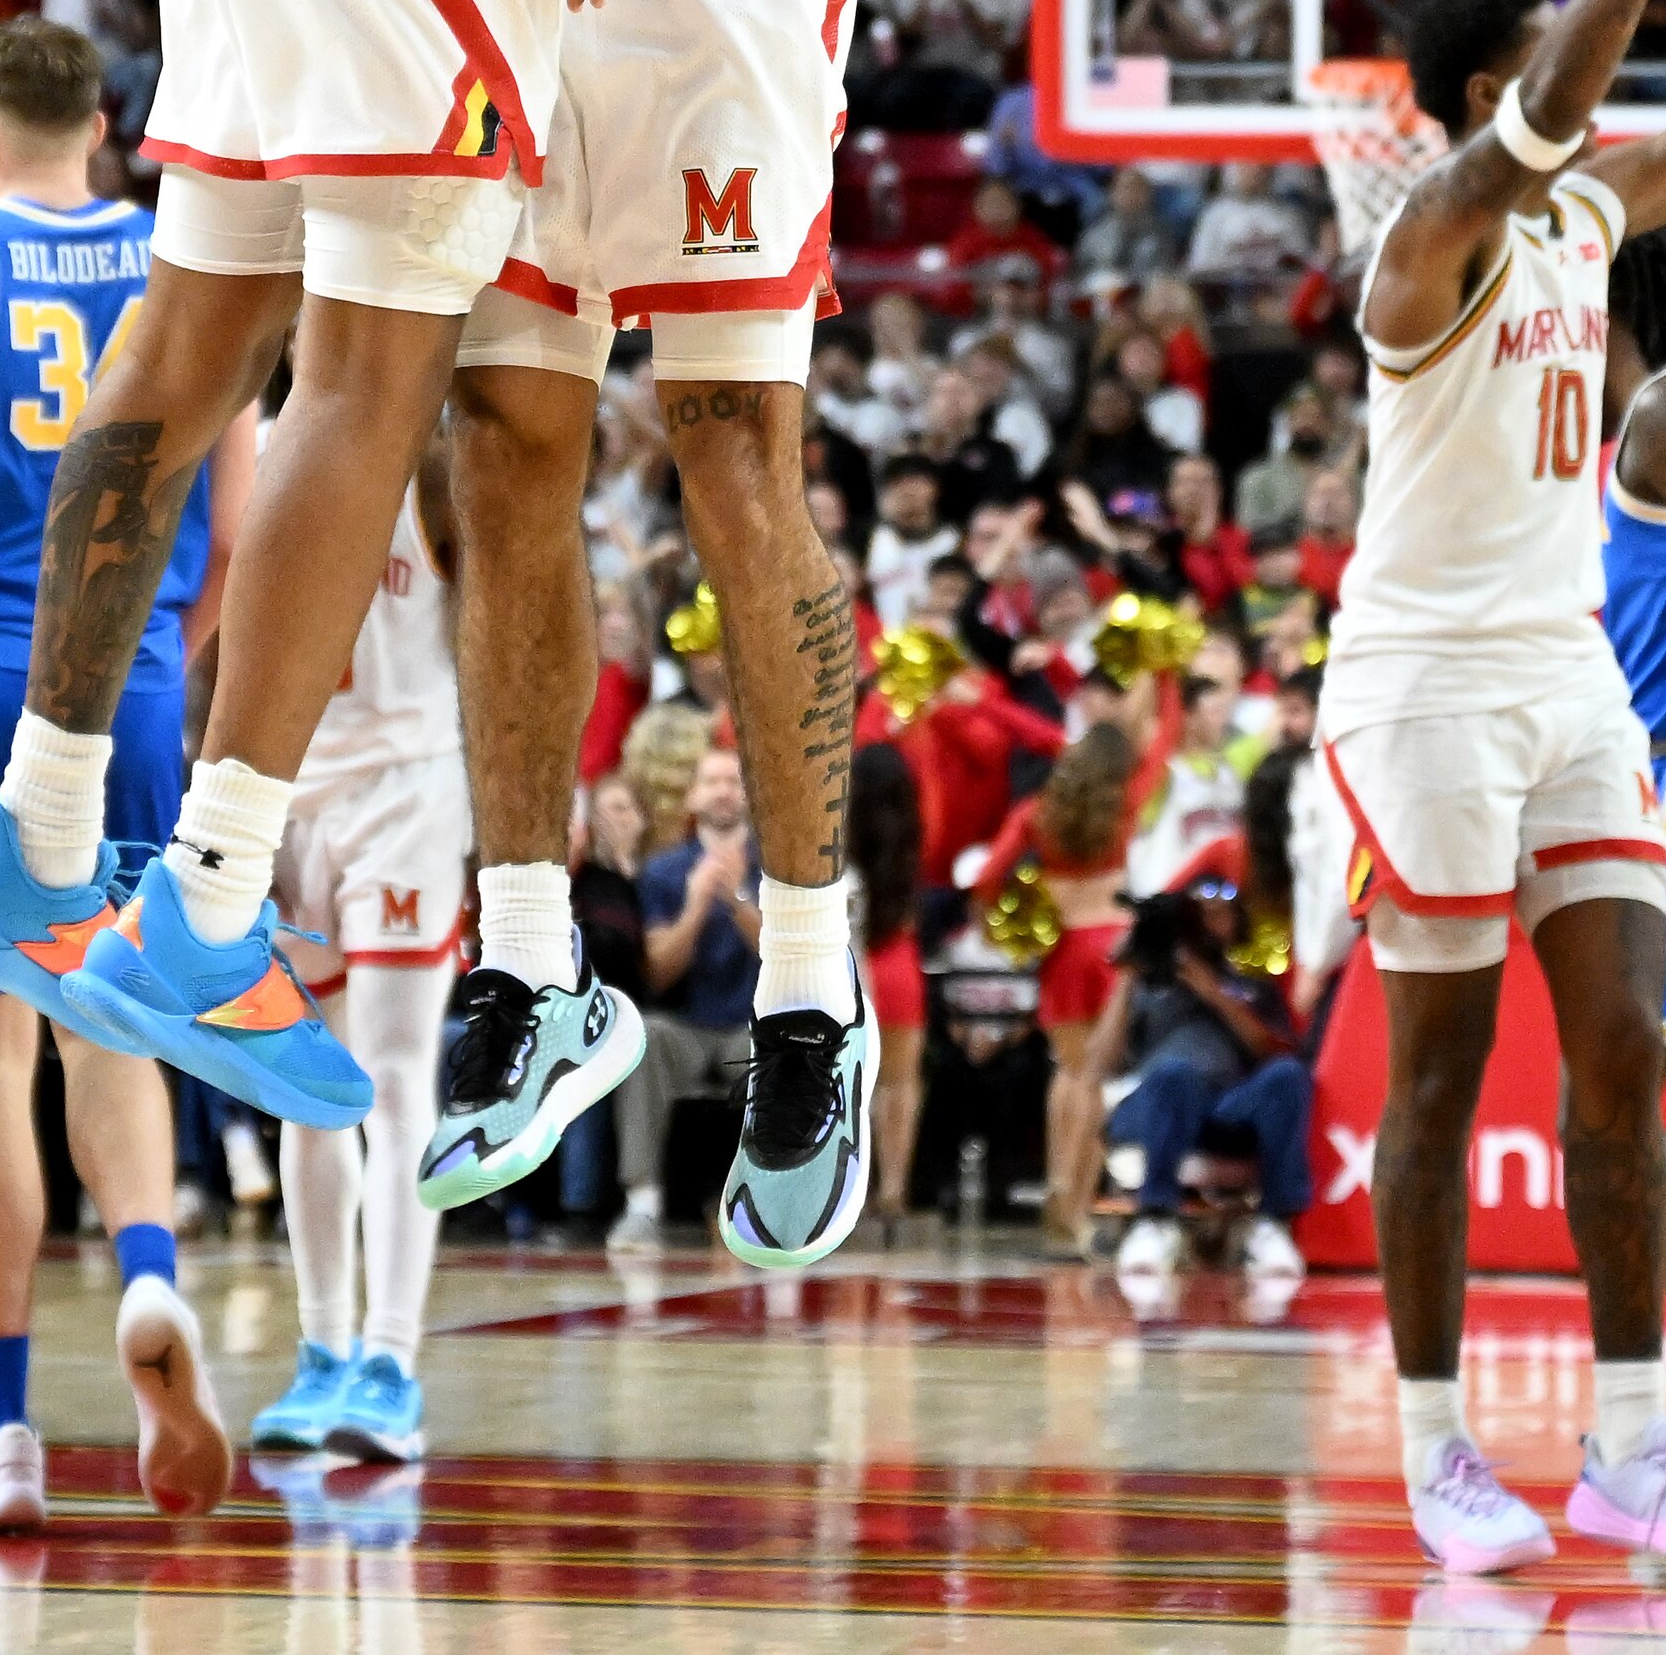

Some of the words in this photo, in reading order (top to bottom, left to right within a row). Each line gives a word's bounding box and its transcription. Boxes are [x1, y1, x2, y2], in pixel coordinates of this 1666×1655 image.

[681, 167, 759, 244] M
[1533, 368, 1589, 482] 10
[381, 887, 421, 930] M
